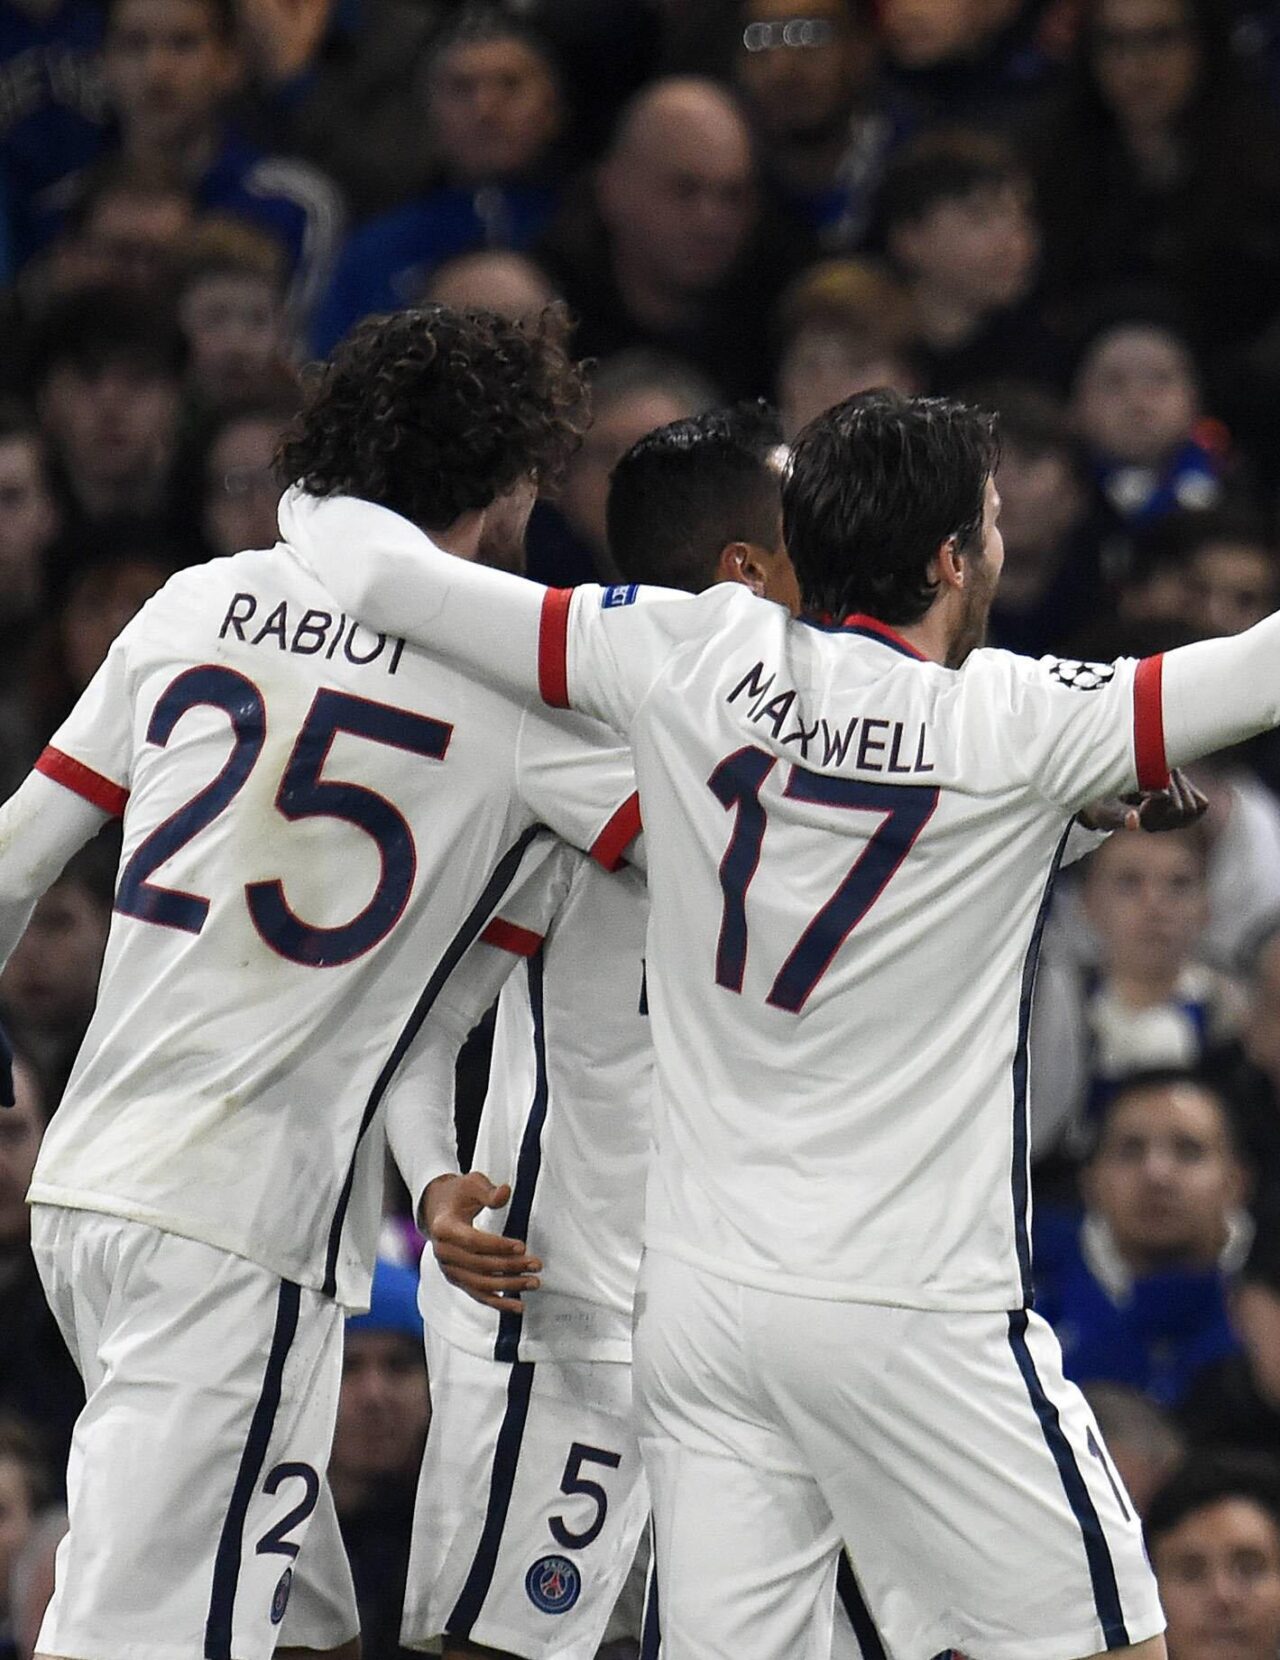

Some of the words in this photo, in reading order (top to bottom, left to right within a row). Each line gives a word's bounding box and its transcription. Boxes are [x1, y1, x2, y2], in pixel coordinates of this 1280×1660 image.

[726, 661, 935, 773] MAXWELL
[113, 663, 455, 968] 25
[706, 744, 941, 1015] 17
[255, 1461, 320, 1561] 2
[547, 1441, 622, 1551] 5
